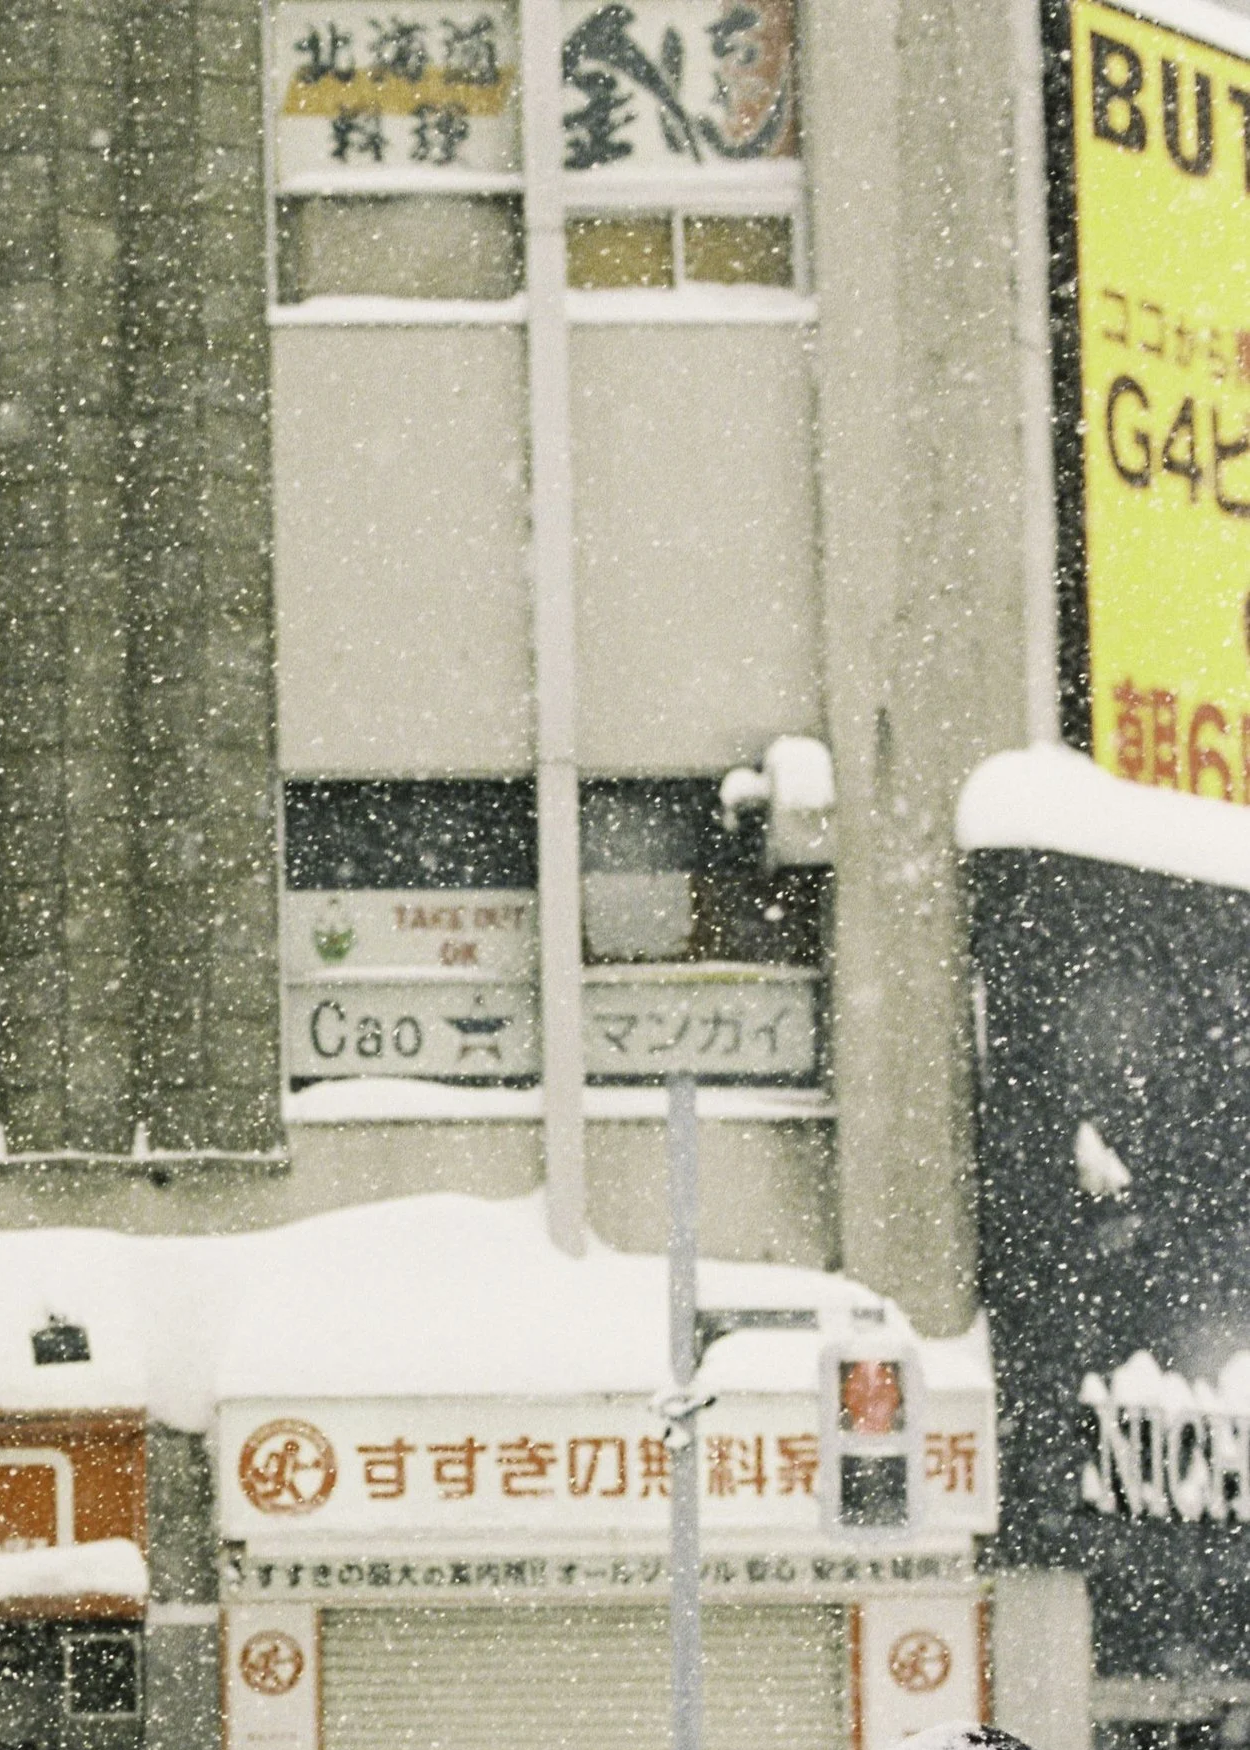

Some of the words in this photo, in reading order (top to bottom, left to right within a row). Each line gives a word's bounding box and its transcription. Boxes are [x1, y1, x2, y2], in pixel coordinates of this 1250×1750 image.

[295, 14, 500, 86] 北海道
[330, 103, 470, 166] 料理
[1114, 675, 1250, 806] 朝6
[393, 904, 462, 930] TAKE
[473, 904, 526, 931] OUT
[440, 941, 480, 967] OK
[310, 1001, 424, 1059] Cao
